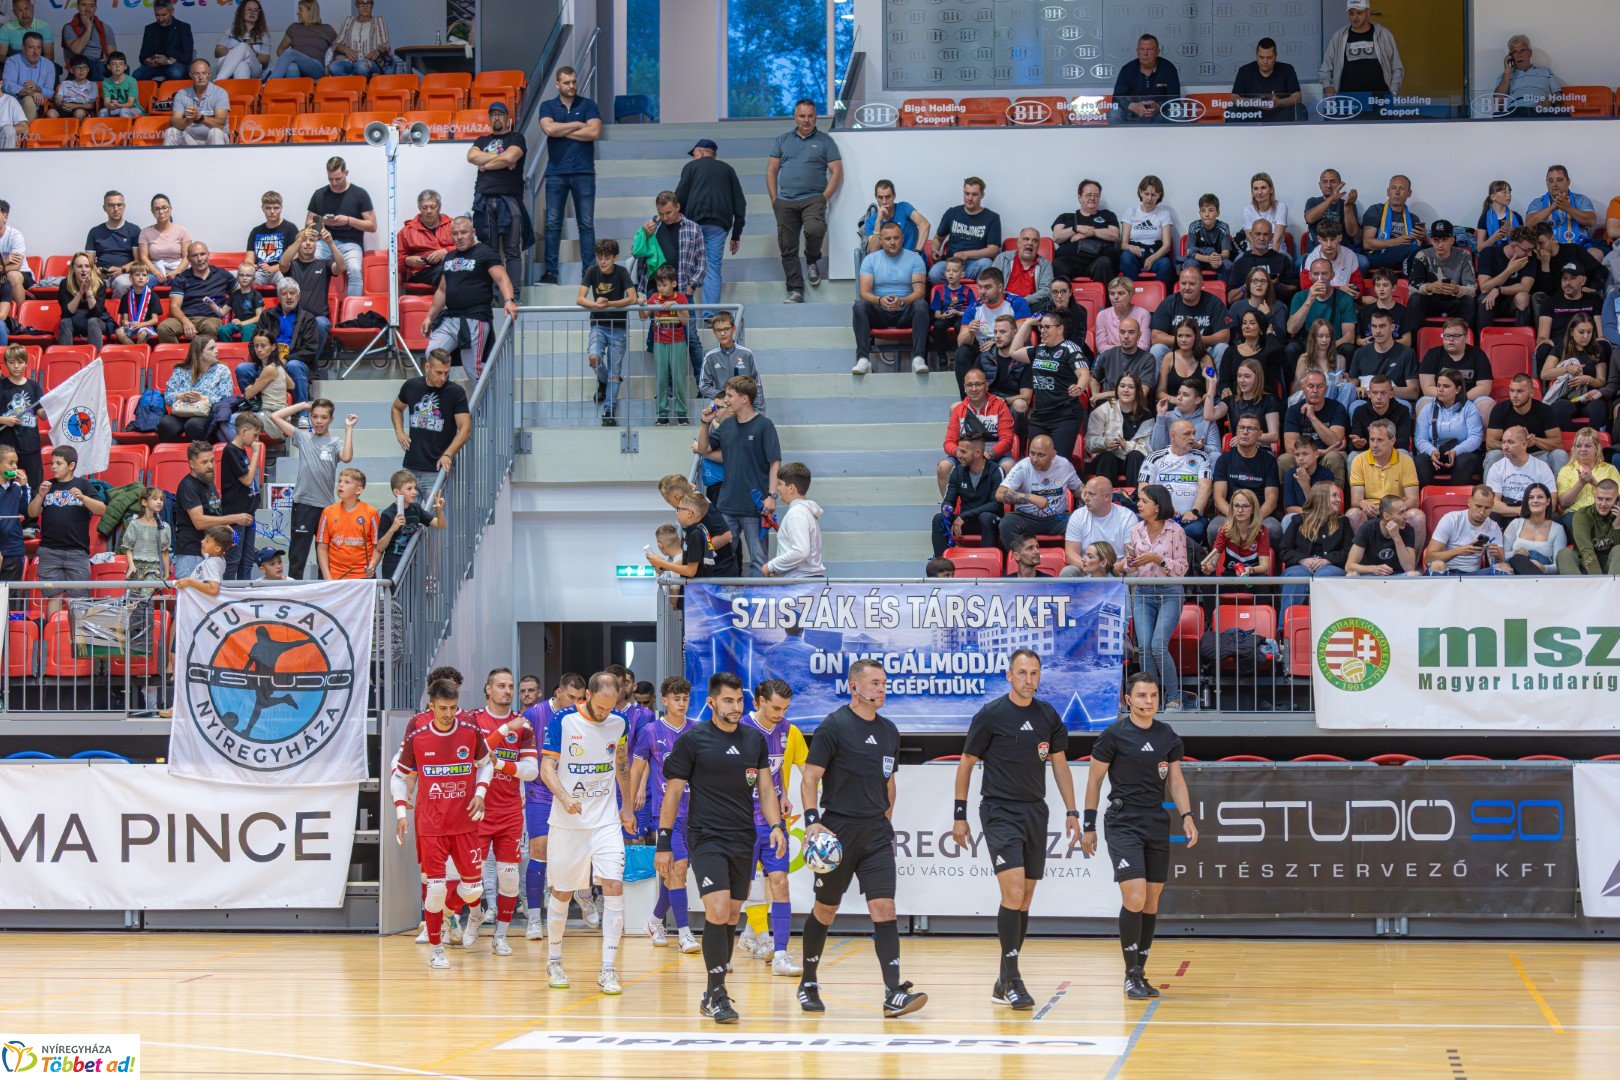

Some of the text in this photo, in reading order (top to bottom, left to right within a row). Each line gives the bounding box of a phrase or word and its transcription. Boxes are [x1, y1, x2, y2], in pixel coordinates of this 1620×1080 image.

[1062, 28, 1079, 37] BH
[1079, 47, 1096, 57] BH
[1211, 98, 1274, 109] Bige Holding
[1324, 99, 1354, 116] BH
[1368, 96, 1431, 106] Bige Holding
[1480, 97, 1509, 113] BH
[863, 107, 891, 123] BH
[904, 104, 966, 113] Bige Holding
[1015, 105, 1044, 121] BH
[1168, 102, 1198, 118] BH
[1223, 110, 1263, 119] Csoport
[1380, 107, 1420, 117] Csoport
[916, 115, 956, 124] Csoport
[268, 125, 338, 137] NYÍREGYHÁZA
[427, 122, 490, 134] YÍREGYHÁZA
[1159, 473, 1198, 482] TIPPMIX
[731, 588, 1077, 630] SZISZÁK ÉS TÁRSA KFT.
[206, 603, 334, 646] FUTSAL
[809, 649, 848, 675] ÖN
[885, 675, 986, 696] EGÉPÍTJÜK!
[1342, 682, 1365, 691] 1901
[1418, 672, 1501, 693] Magyar
[196, 700, 340, 763] NYÍREGYHÁZA
[423, 763, 471, 775] TIPPMIX
[429, 790, 466, 799] STUDIO
[1469, 799, 1564, 843] 90
[121, 811, 332, 863] PINCE
[922, 864, 965, 877] VÁROS
[1496, 863, 1556, 877] KFT
